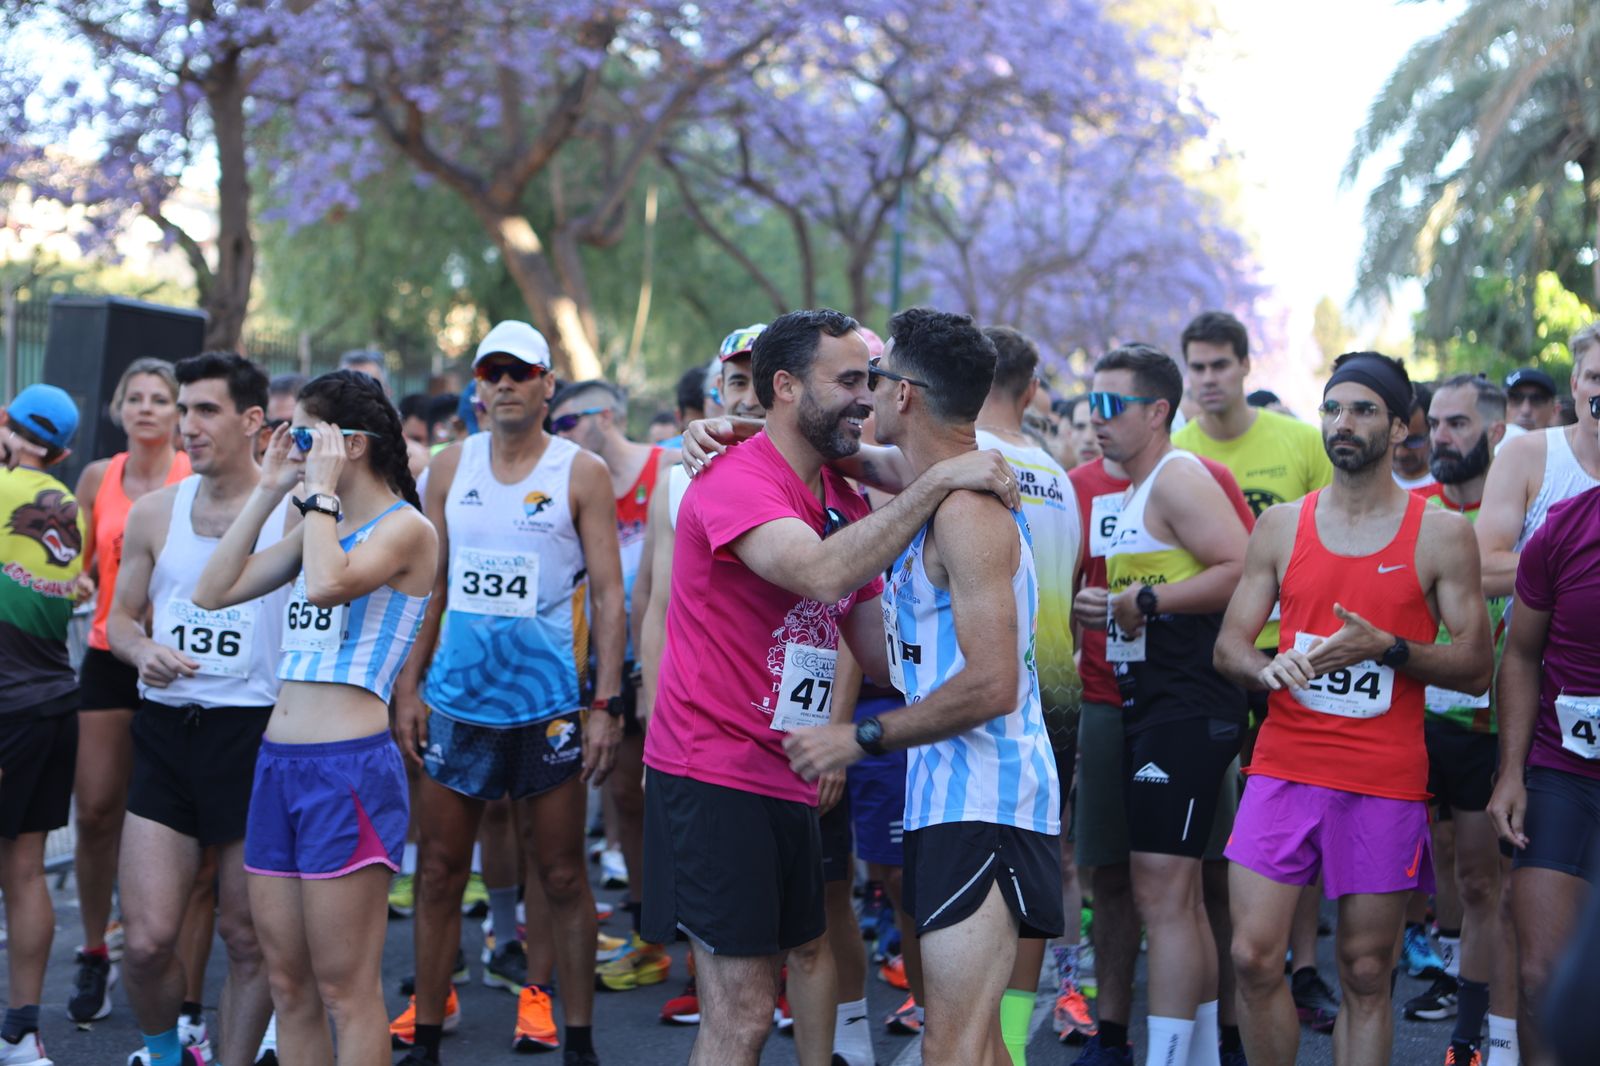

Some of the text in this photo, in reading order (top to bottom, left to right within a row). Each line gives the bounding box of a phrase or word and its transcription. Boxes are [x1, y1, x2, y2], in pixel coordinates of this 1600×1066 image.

[462, 571, 528, 599] 334
[288, 601, 333, 631] 658
[171, 624, 242, 657] 136
[790, 677, 834, 713] 47
[1571, 719, 1600, 745] 4
